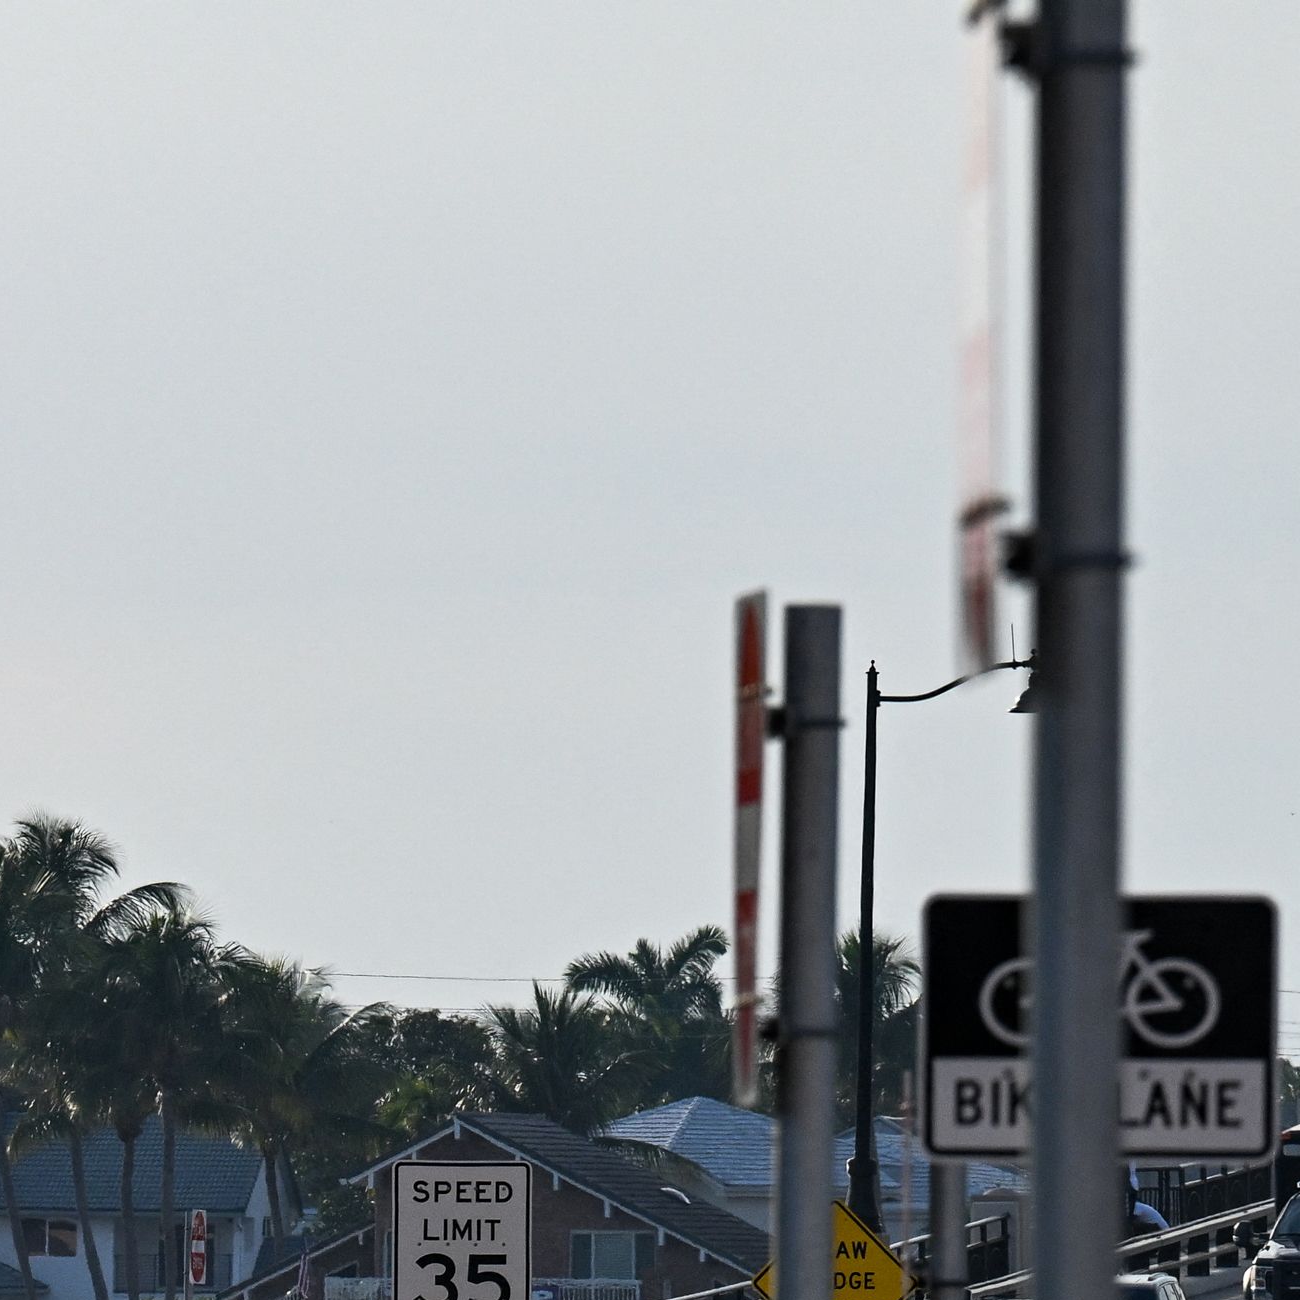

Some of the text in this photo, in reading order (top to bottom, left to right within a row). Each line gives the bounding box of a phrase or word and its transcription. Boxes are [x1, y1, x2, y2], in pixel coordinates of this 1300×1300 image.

[954, 1077, 1242, 1128] BIK LANE
[412, 1180, 513, 1204] SPEED
[423, 1218, 501, 1242] LIMIT
[835, 1240, 868, 1260] AW
